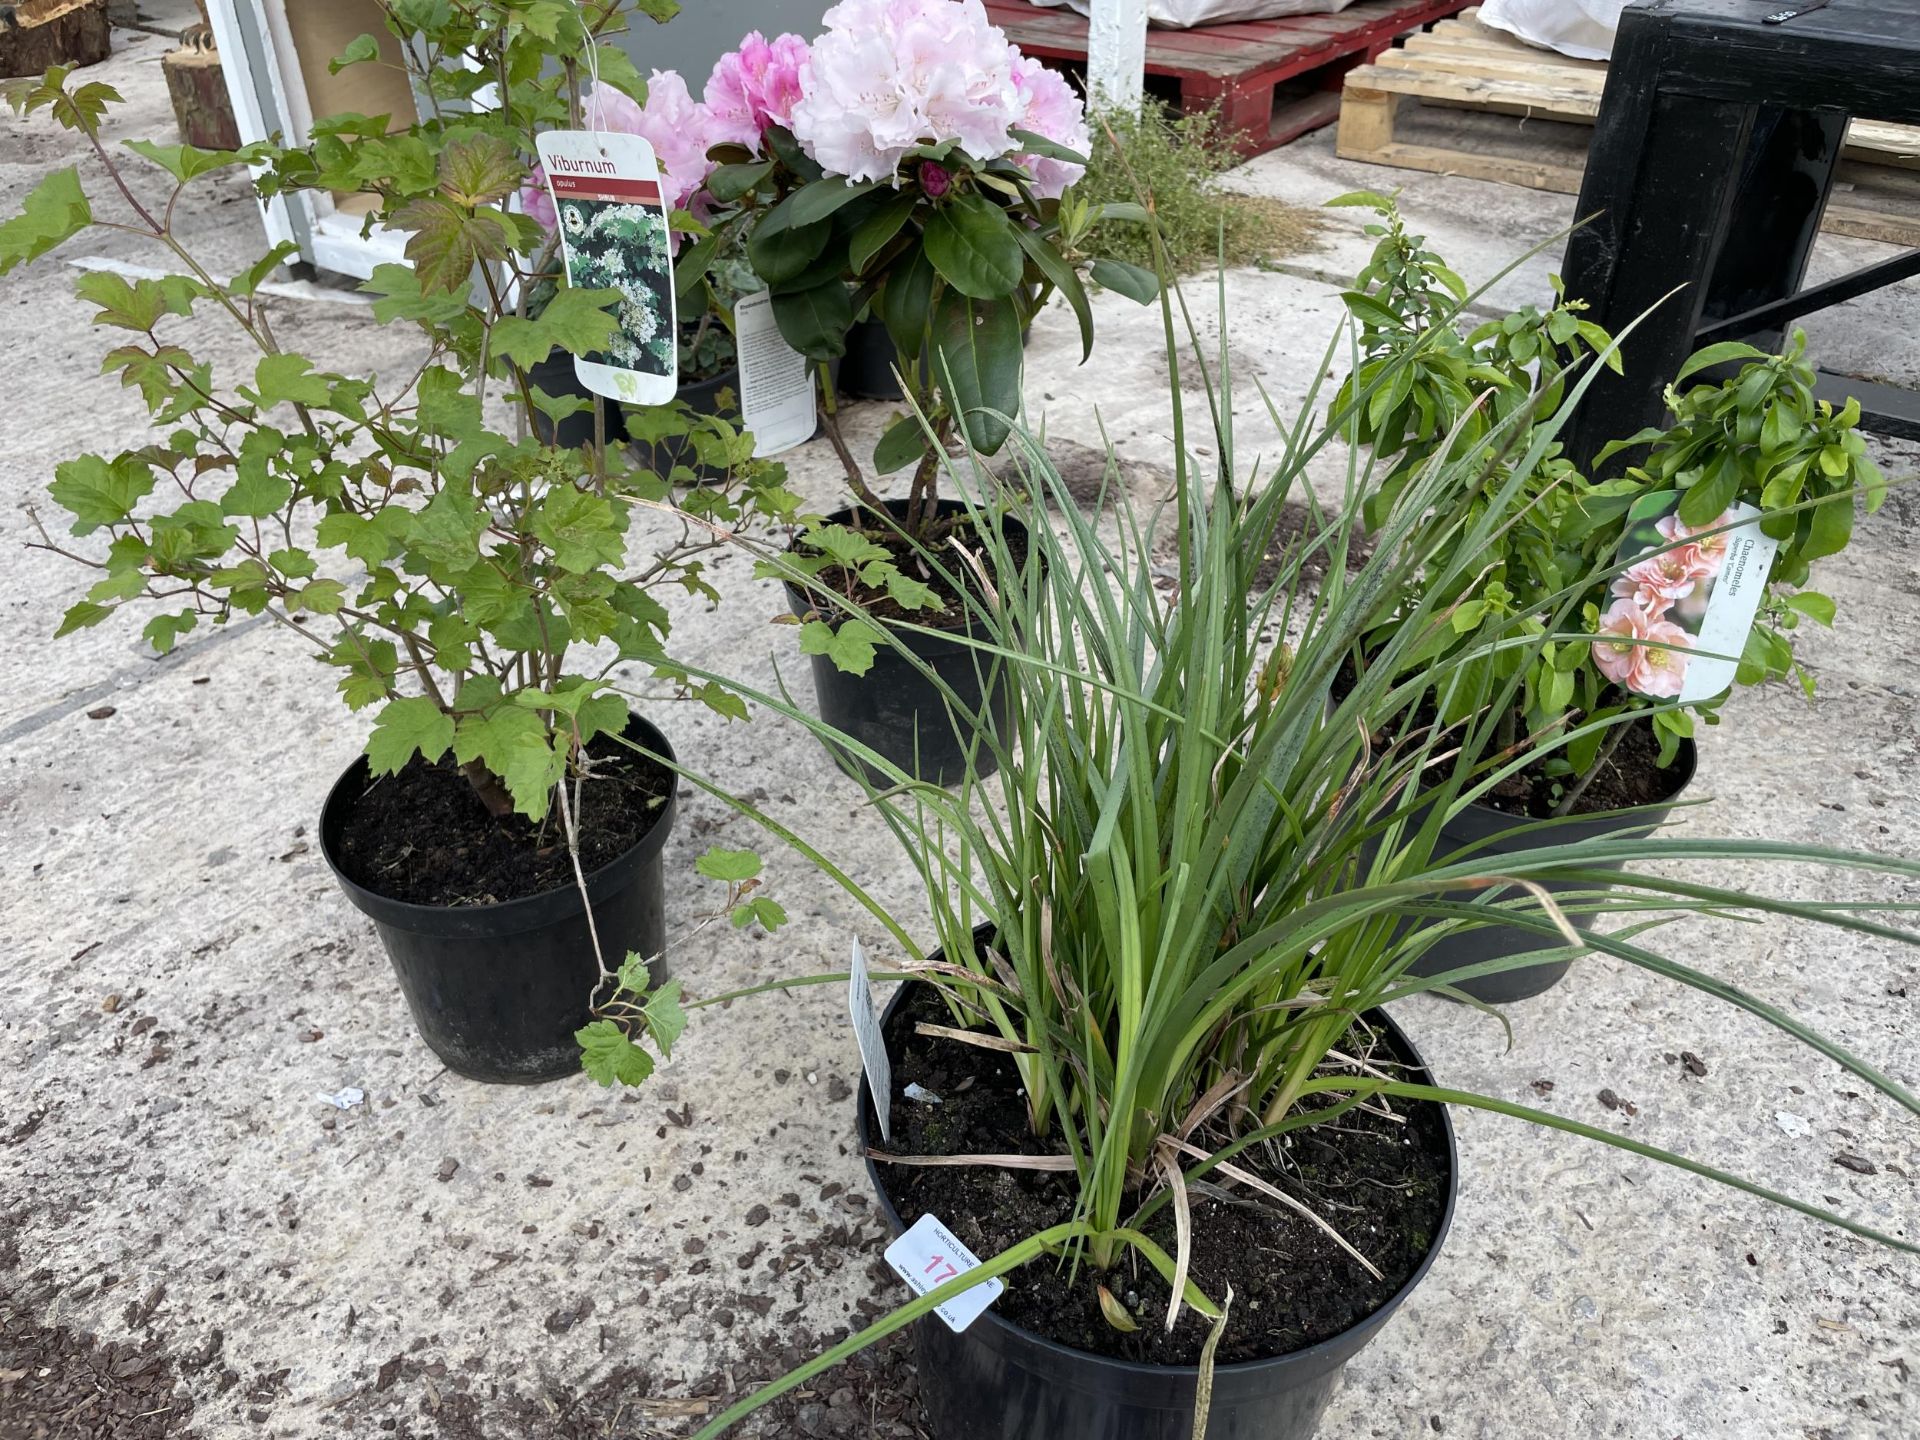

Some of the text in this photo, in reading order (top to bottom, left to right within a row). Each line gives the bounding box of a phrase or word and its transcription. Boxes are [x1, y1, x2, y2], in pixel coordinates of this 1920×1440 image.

[547, 154, 617, 174] Viburnum
[556, 180, 576, 188] opulus
[1729, 539, 1755, 597] Chaenomeles
[933, 1227, 975, 1269] HORTICULTURE
[924, 1255, 959, 1284] 17
